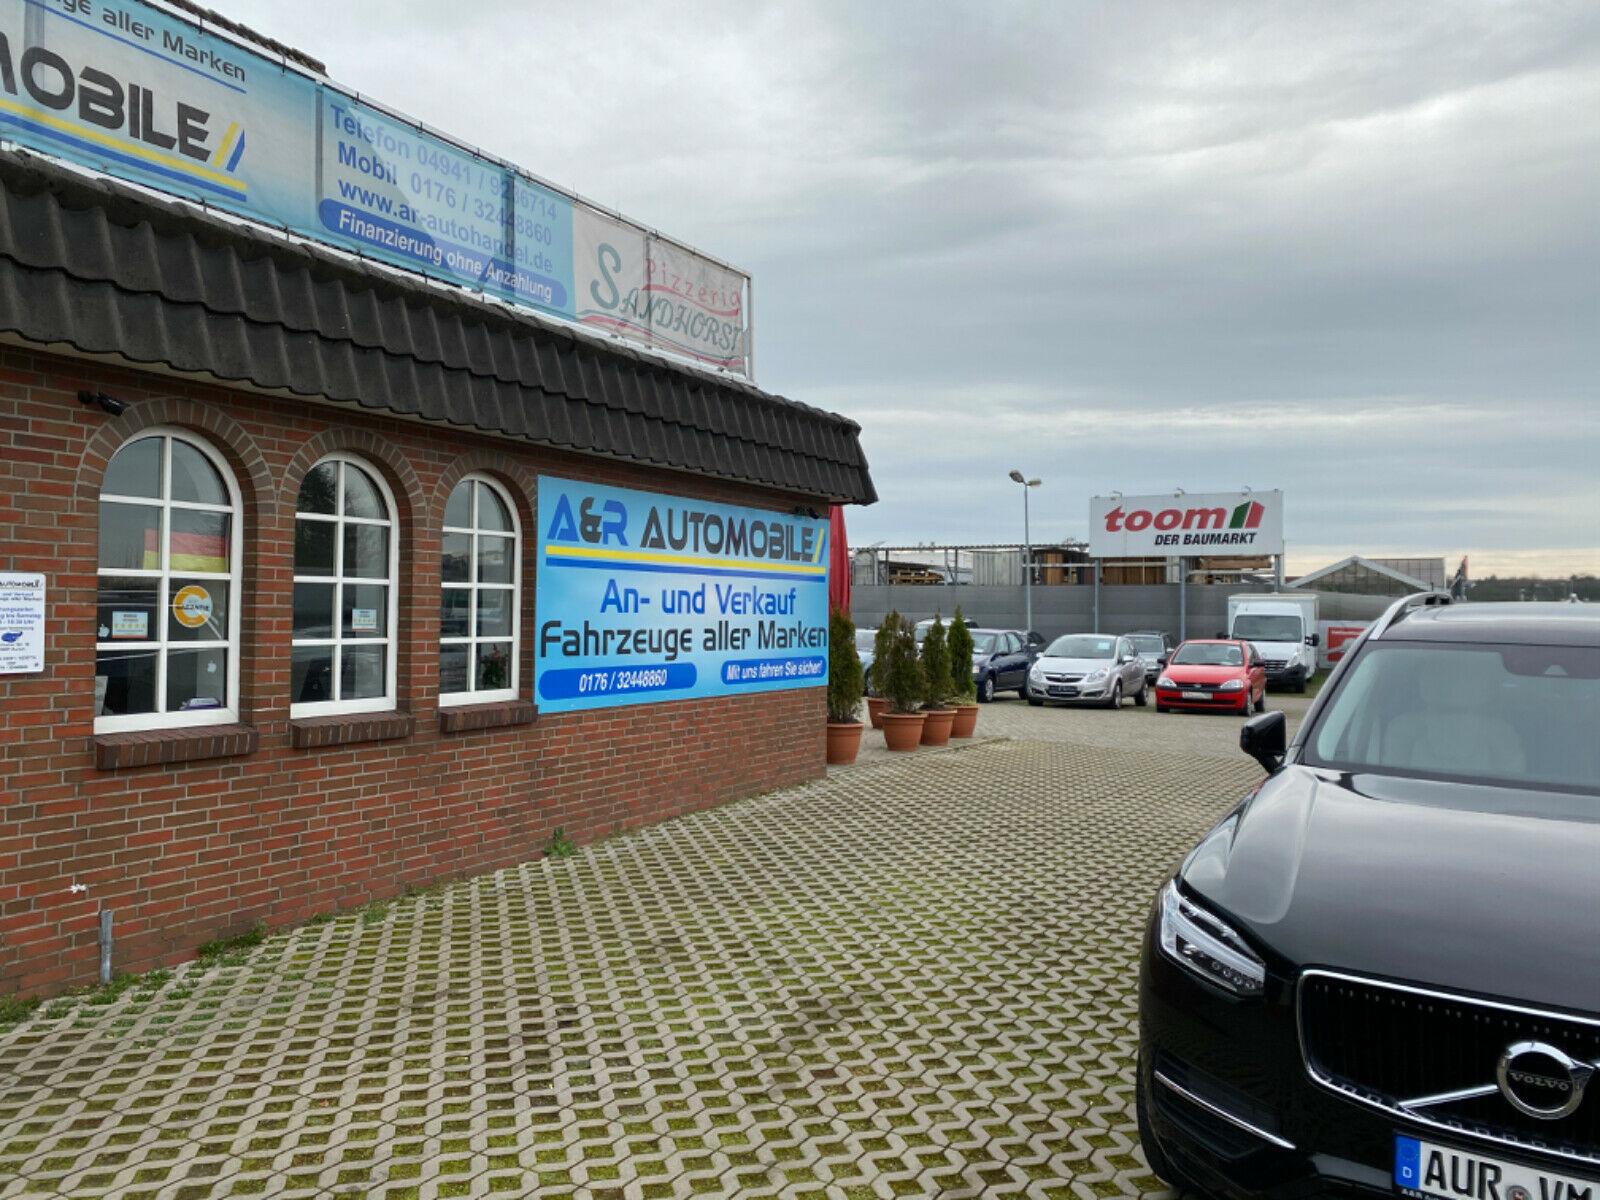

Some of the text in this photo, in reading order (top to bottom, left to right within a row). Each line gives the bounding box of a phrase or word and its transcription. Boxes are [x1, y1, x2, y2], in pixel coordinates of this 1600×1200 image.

[102, 7, 154, 41] aller
[162, 29, 246, 82] Marken
[330, 103, 410, 159] Telefon
[417, 144, 471, 184] 04941
[338, 141, 397, 185] Mobil
[410, 171, 456, 209] 0176
[474, 198, 552, 246] 32448860
[338, 179, 554, 274] www.ar-autohandel.de
[339, 209, 553, 304] Finanzierung ohne Anzahlung
[547, 493, 814, 562] A&R AUTOMOBILE
[1104, 505, 1228, 533] toom
[1154, 532, 1257, 546] DER BAUMARKT
[600, 578, 797, 616] An- und Verkauf
[540, 620, 827, 662] Fahrzeuge aller Marken
[578, 672, 609, 693] 0176
[1510, 1072, 1570, 1091] VOLVO
[1424, 1150, 1502, 1200] AUR
